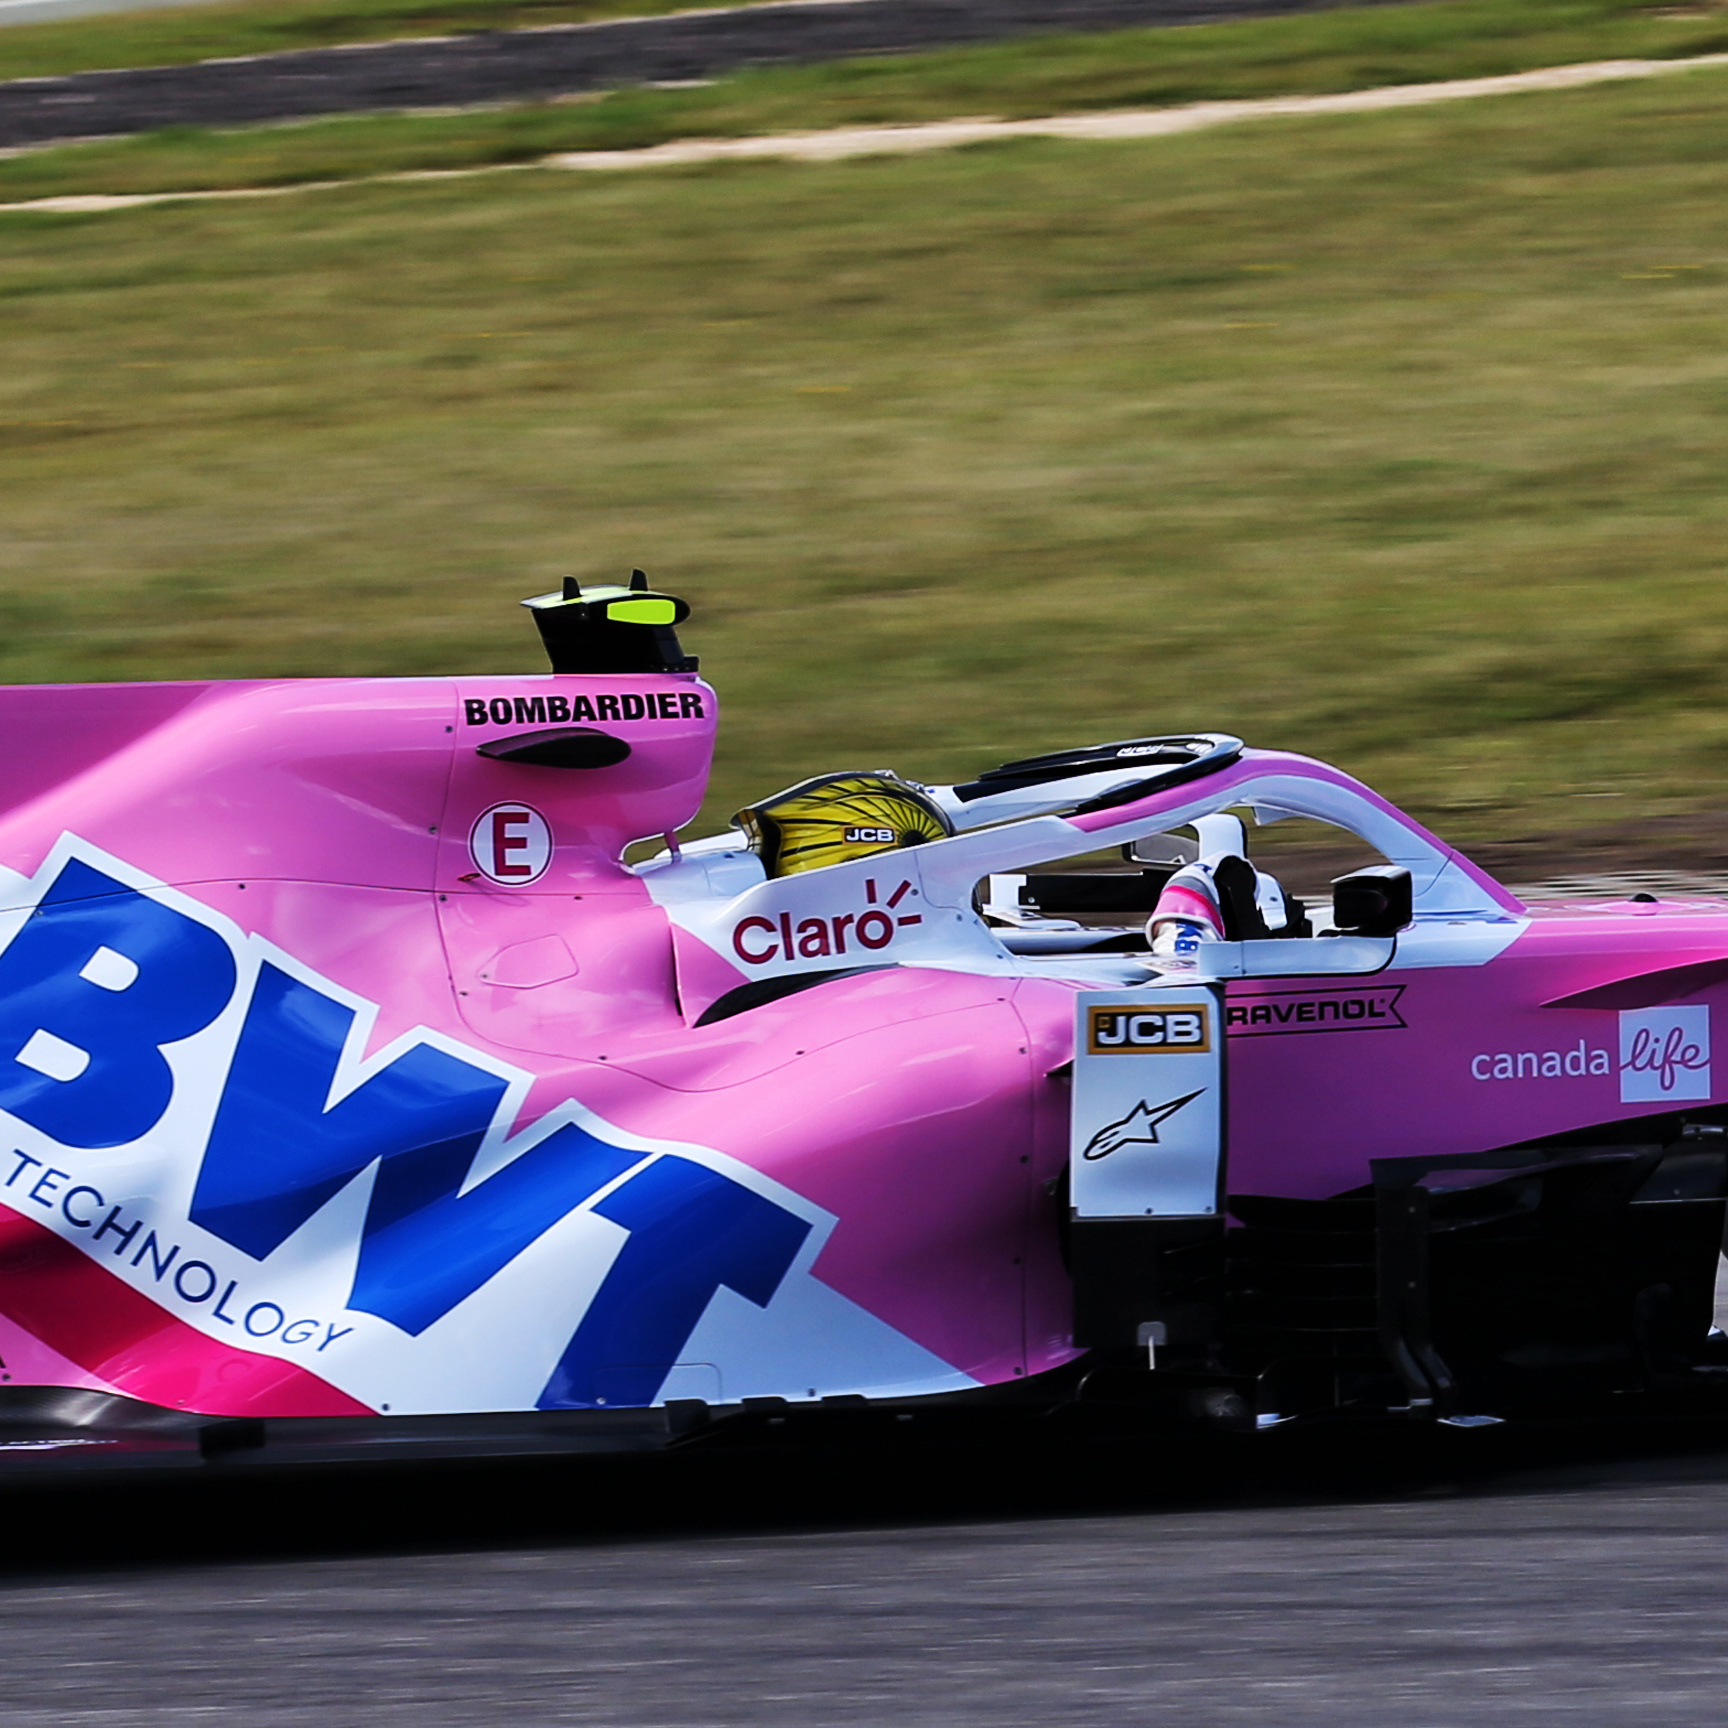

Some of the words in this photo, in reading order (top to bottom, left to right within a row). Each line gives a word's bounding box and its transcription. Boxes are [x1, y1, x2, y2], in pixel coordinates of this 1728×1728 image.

[464, 693, 705, 726] BOMBARDIER
[492, 811, 532, 876] E
[845, 828, 894, 842] JCB
[733, 910, 894, 964] Claro
[1097, 1014, 1201, 1044] JCB
[1226, 999, 1386, 1025] RAVENOL
[1471, 1039, 1610, 1080] canada
[1619, 1027, 1710, 1091] life
[4, 1148, 356, 1352] TECHNOLOGY
